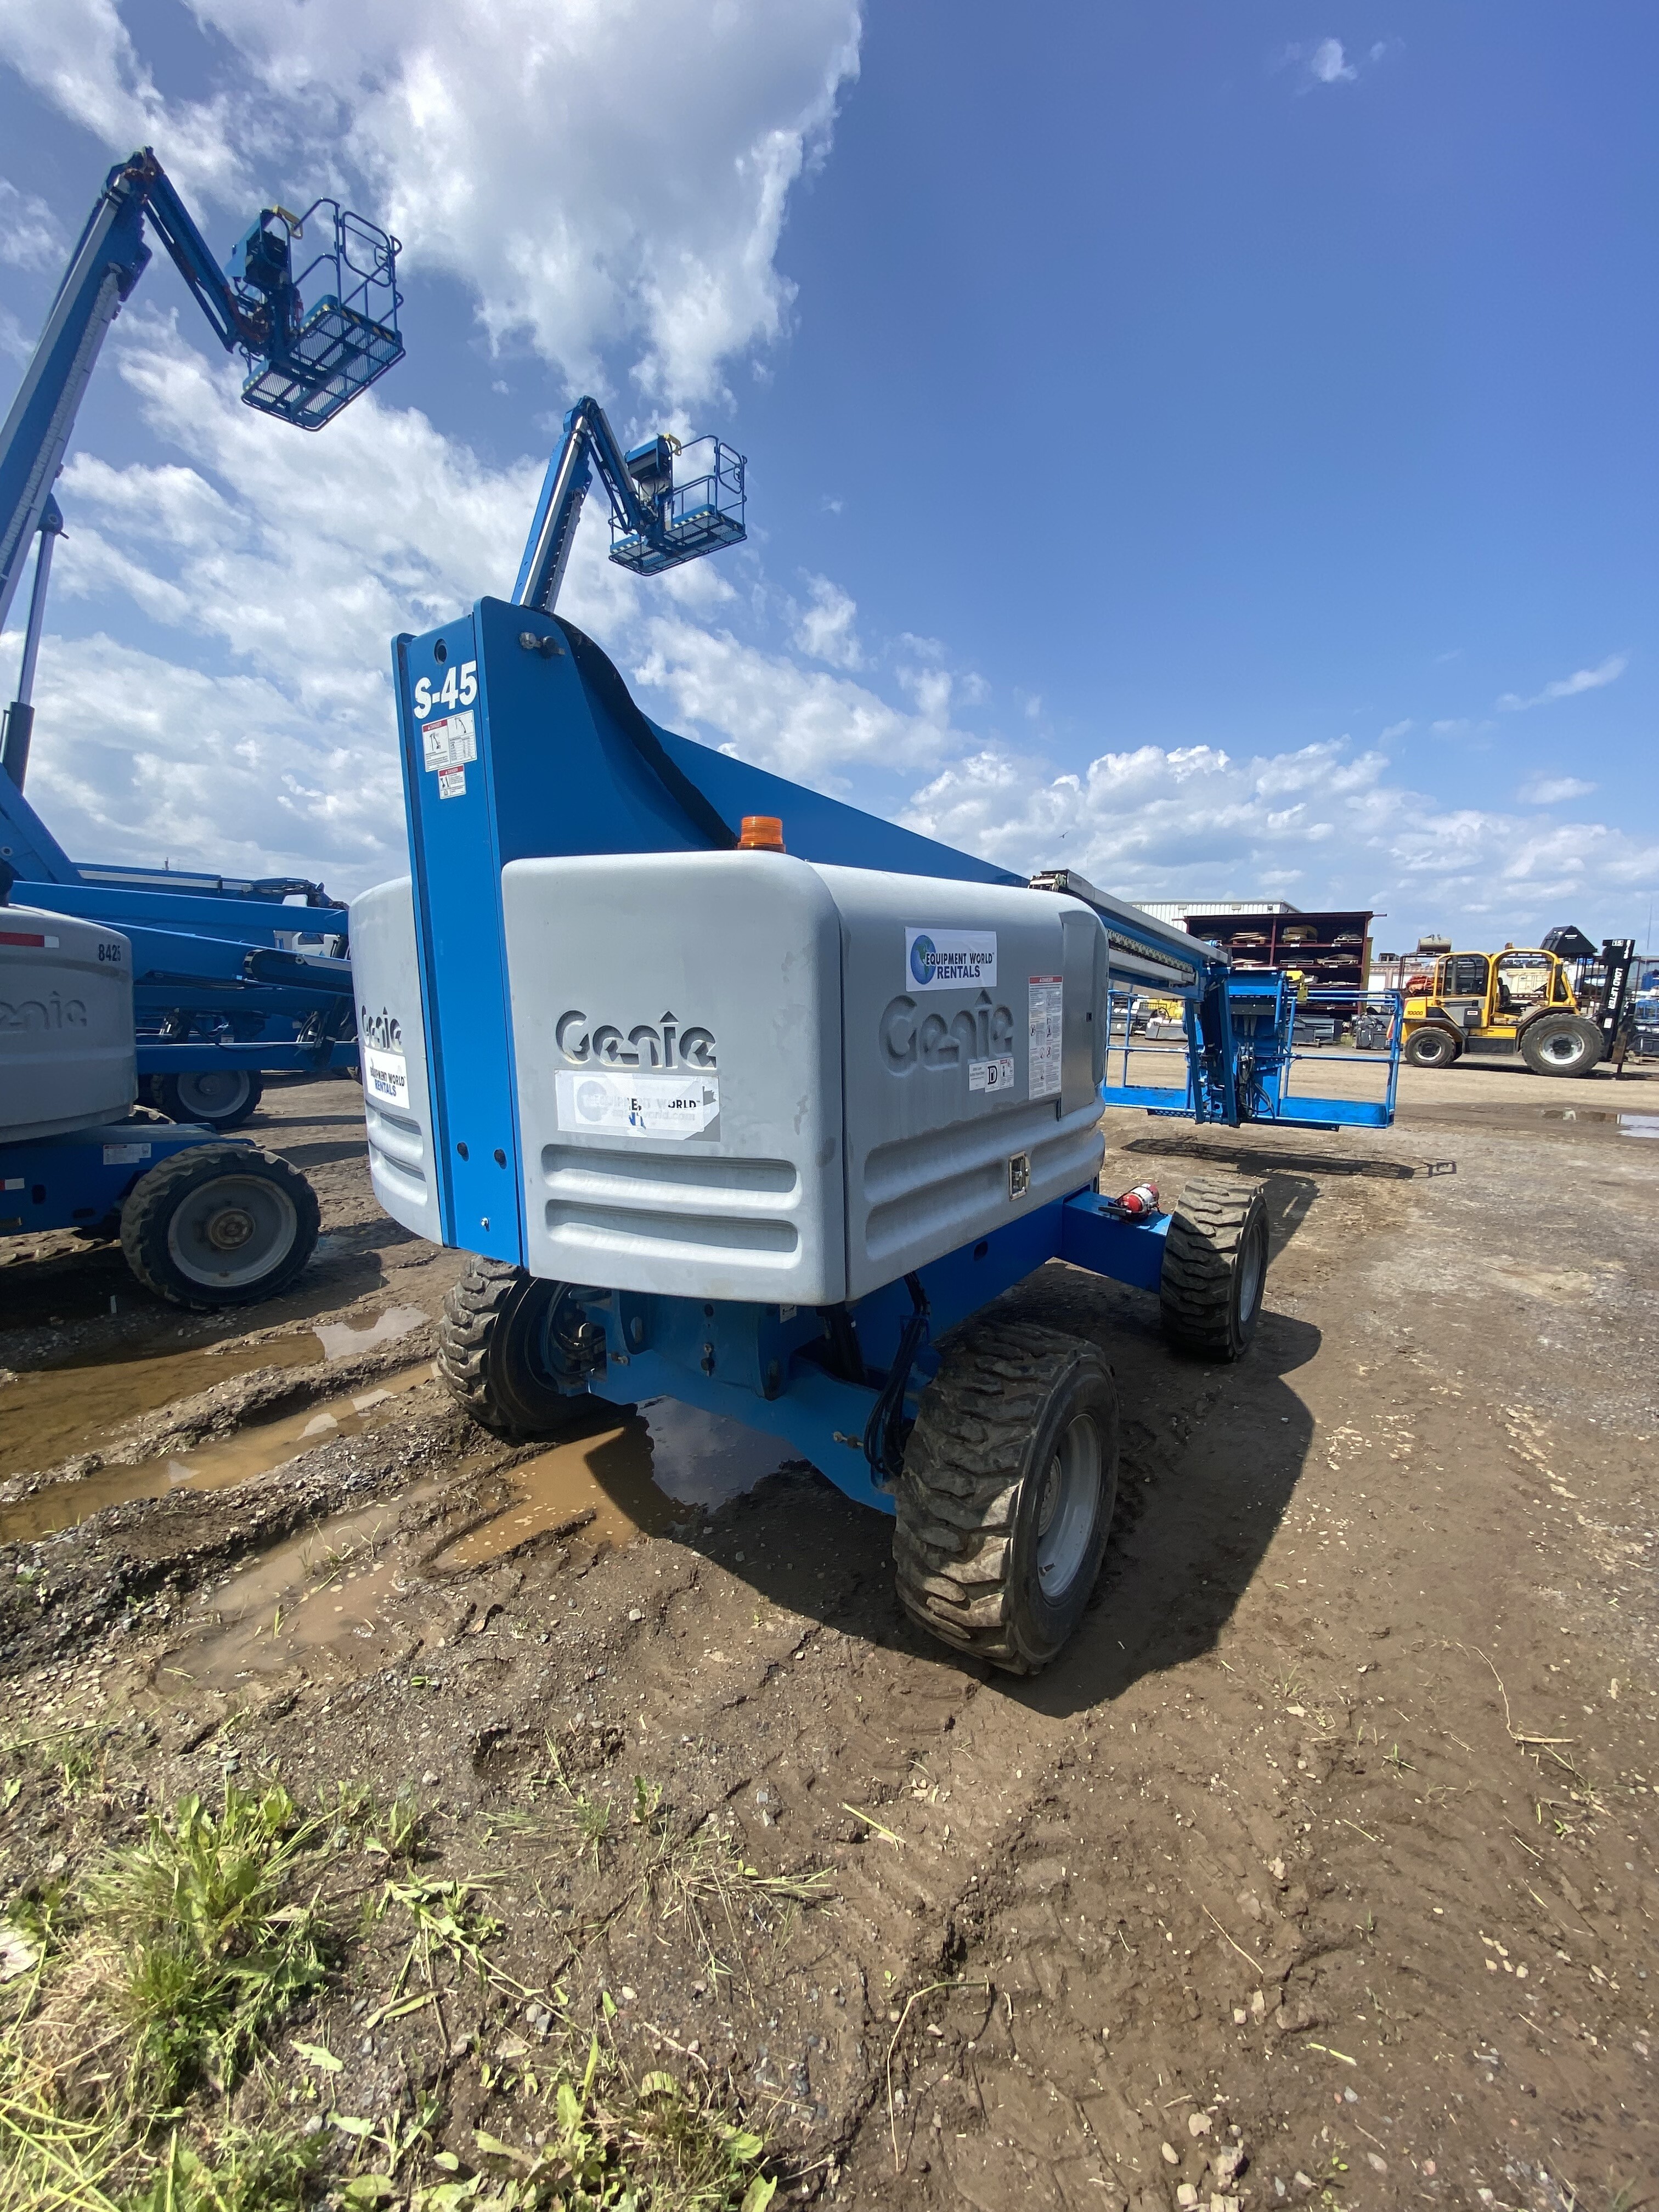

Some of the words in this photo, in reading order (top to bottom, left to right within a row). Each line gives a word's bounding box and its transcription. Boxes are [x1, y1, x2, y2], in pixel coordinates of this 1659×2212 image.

[414, 660, 477, 719] S-45
[98, 944, 121, 961] 8425
[926, 952, 967, 965] EQUIPMENT
[969, 952, 992, 964] WORLD
[937, 965, 980, 979] RENTALS
[1613, 967, 1623, 986] LOAD
[1608, 987, 1619, 1009] LIFTER
[0, 990, 87, 1034] enie
[362, 1005, 403, 1053] Genie
[879, 989, 1014, 1077] Genie
[556, 1010, 717, 1070] Genie
[375, 1079, 397, 1097] RENTALS
[388, 1073, 405, 1086] WORLD
